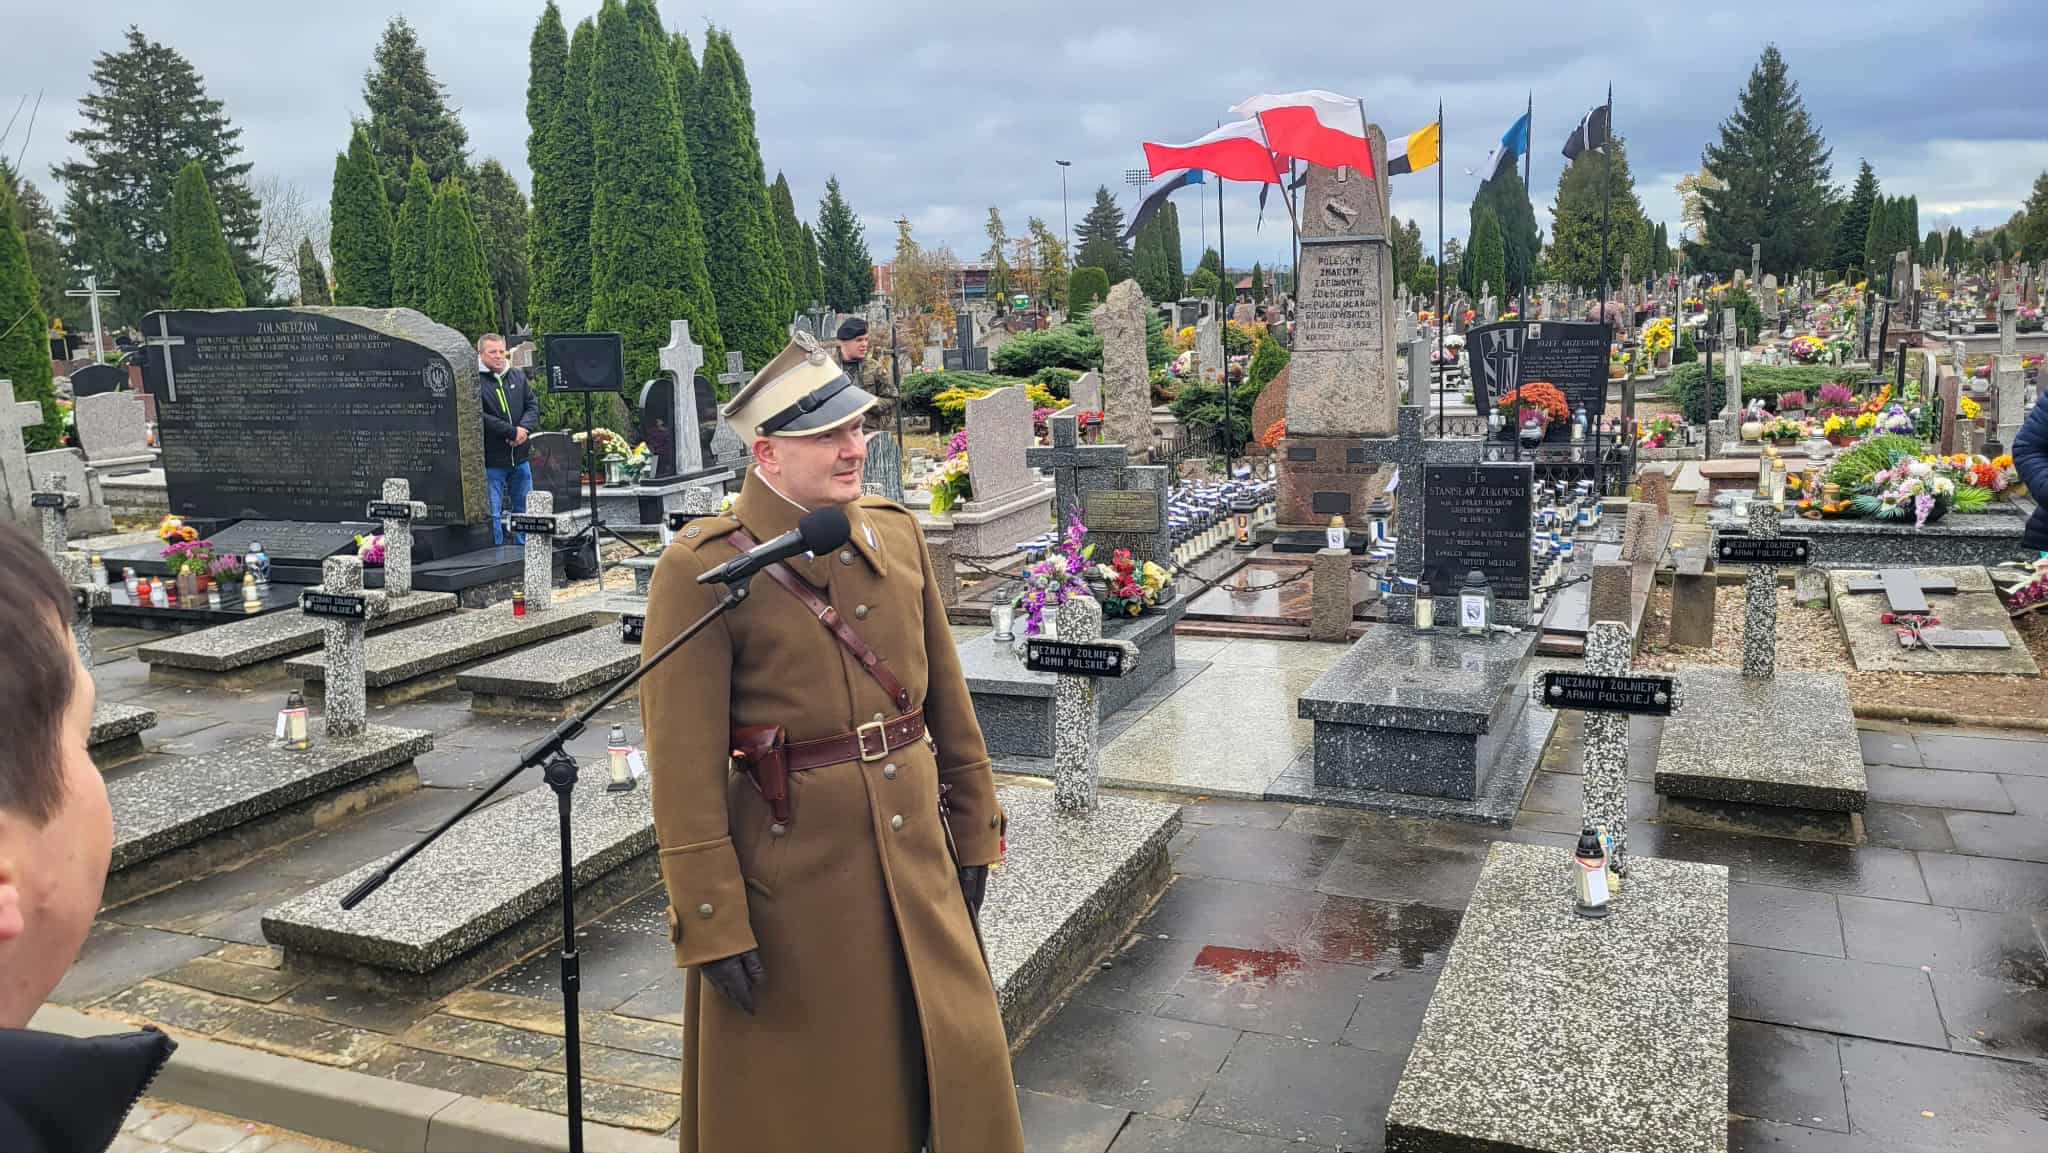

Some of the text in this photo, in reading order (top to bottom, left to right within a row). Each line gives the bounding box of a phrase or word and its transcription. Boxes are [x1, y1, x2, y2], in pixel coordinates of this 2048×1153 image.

[1429, 486, 1477, 497] STANISŁAW
[1039, 656, 1111, 671] ARMII POLSKIEJ
[1554, 676, 1606, 690] NIEZNANY
[1565, 689, 1651, 705] ARMII POLSKIEJ
